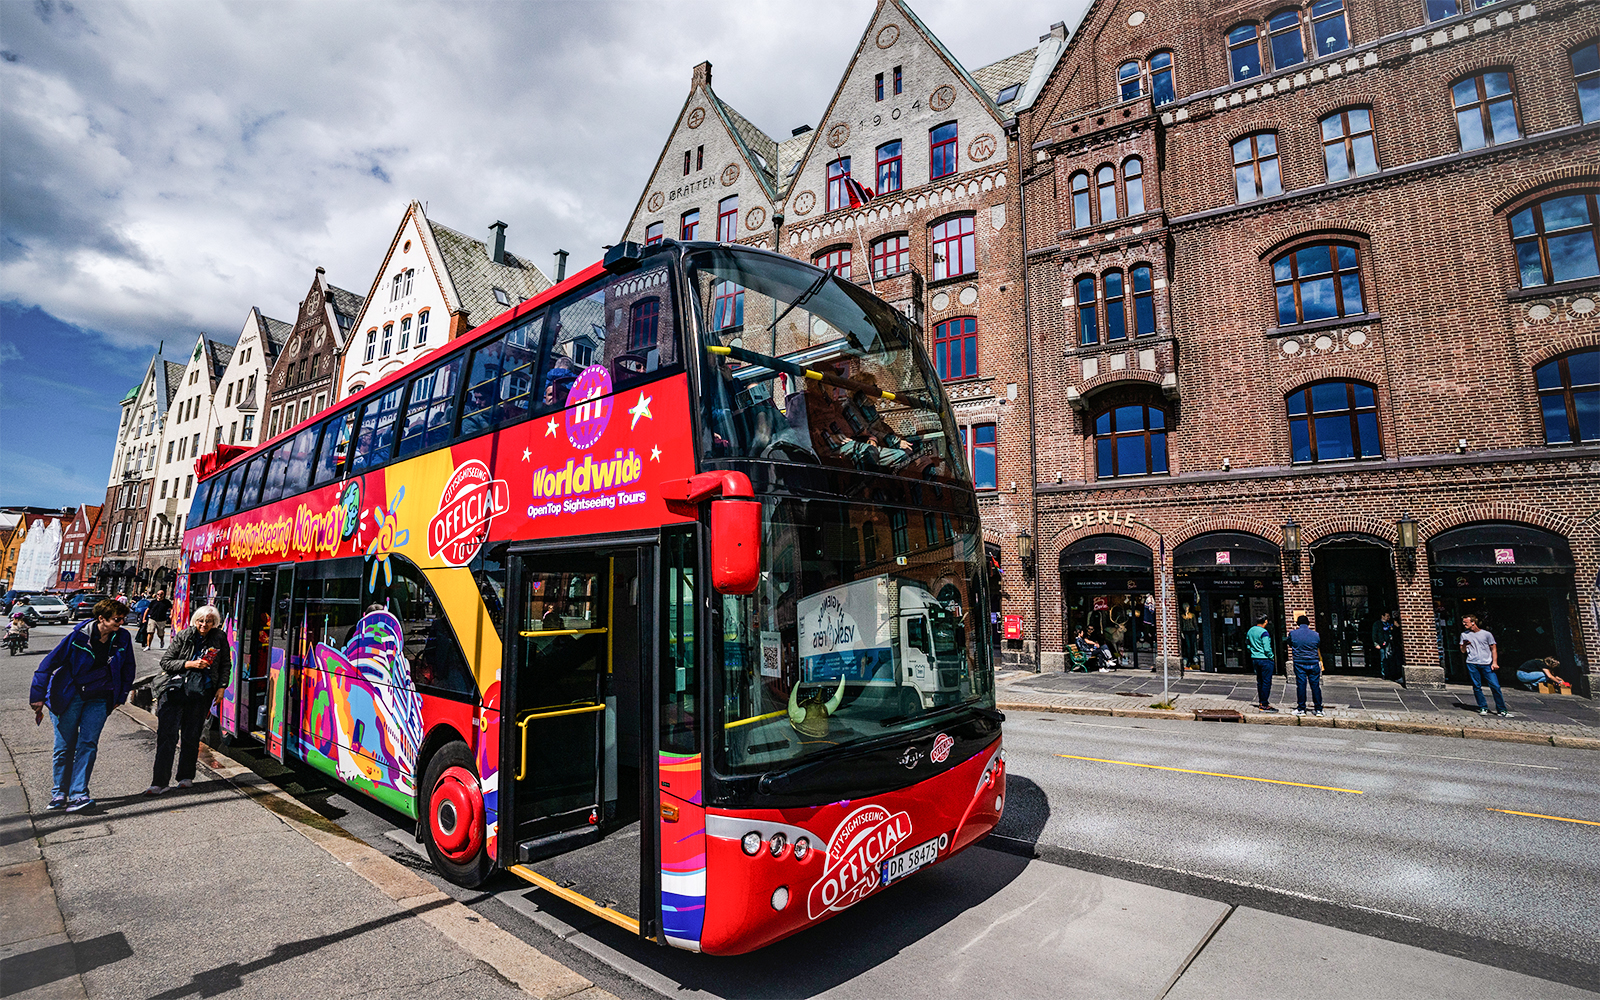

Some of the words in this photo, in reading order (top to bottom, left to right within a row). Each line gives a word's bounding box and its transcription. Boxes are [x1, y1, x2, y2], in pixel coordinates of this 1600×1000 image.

[859, 100, 921, 131] 1904
[669, 175, 716, 201] BRATTEN
[533, 450, 642, 497] Worldwide
[435, 485, 504, 547] OFFICIAL
[527, 503, 562, 518] OpenTop
[563, 494, 616, 513] Sightseeing
[617, 491, 646, 504] Tours
[1070, 510, 1136, 530] BERLE
[292, 503, 348, 557] Norway
[1483, 577, 1539, 586] KNITWEAR
[831, 811, 884, 860] CITYSIGHTSEEING
[821, 817, 907, 906] OFFICIAL
[890, 859, 904, 877] DR
[908, 842, 936, 869] 58475
